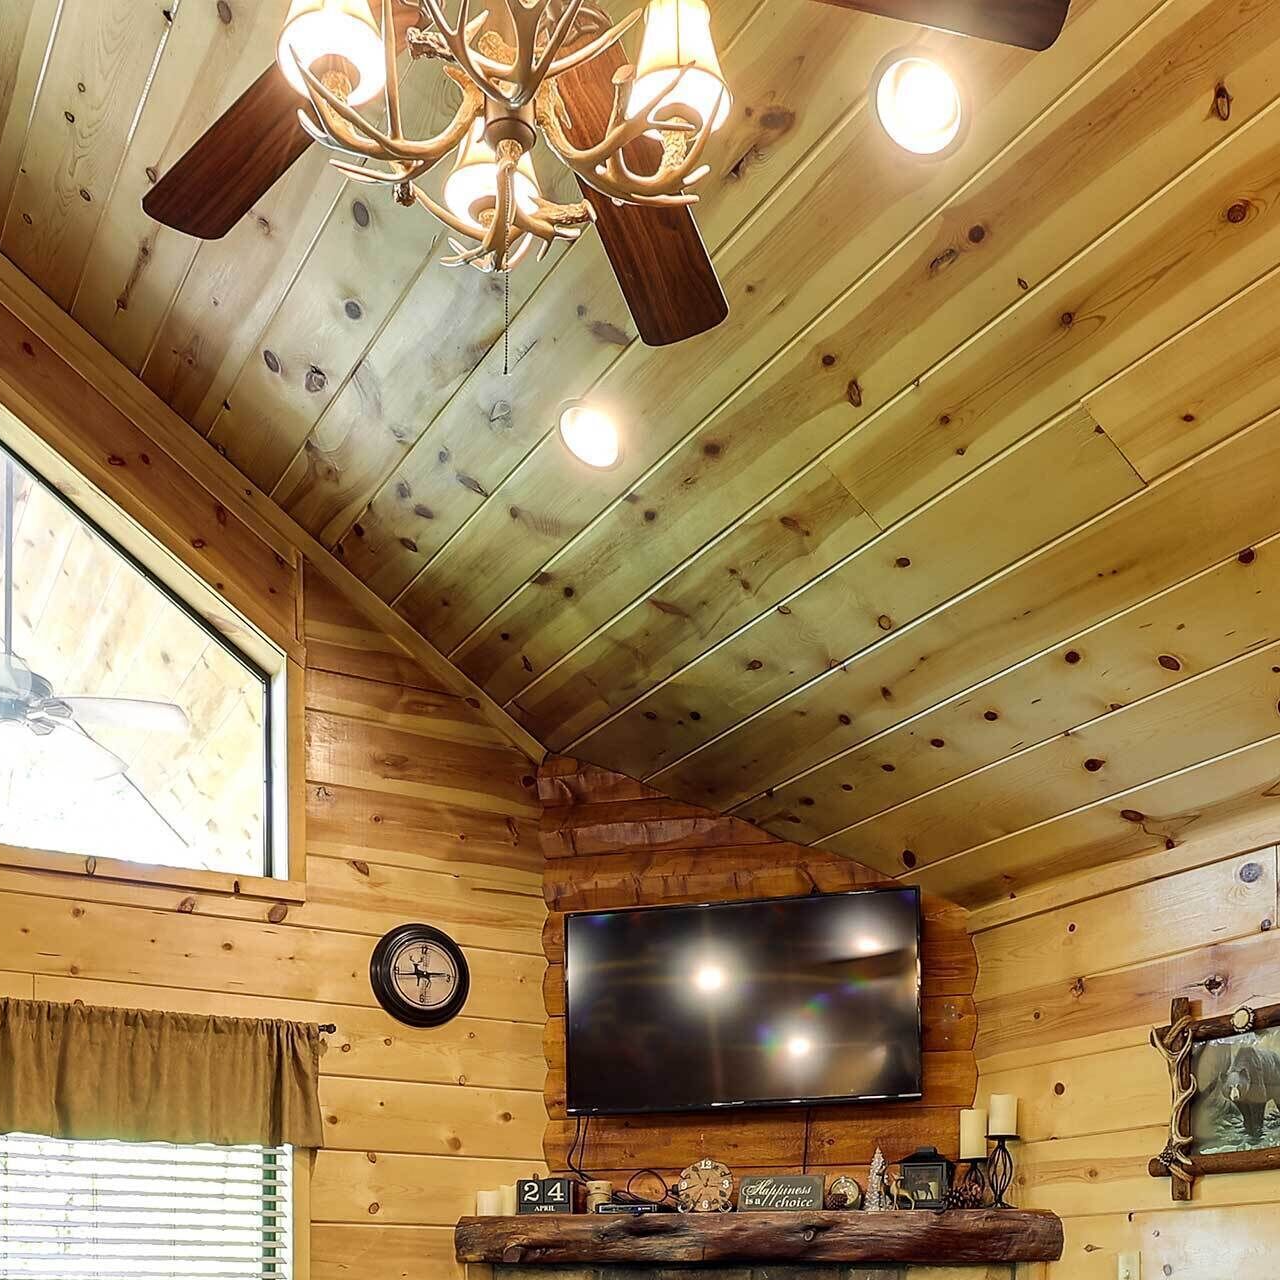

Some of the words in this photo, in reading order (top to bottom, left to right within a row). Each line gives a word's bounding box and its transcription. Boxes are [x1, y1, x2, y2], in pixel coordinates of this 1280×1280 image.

[419, 994, 425, 1003] 6
[700, 1160, 712, 1169] 12
[681, 1181, 688, 1189] 9
[722, 1180, 729, 1189] 3
[523, 1182, 564, 1201] 24
[741, 1179, 812, 1206] Happiness
[702, 1200, 709, 1209] 6
[745, 1195, 753, 1205] is
[775, 1196, 813, 1208] choice
